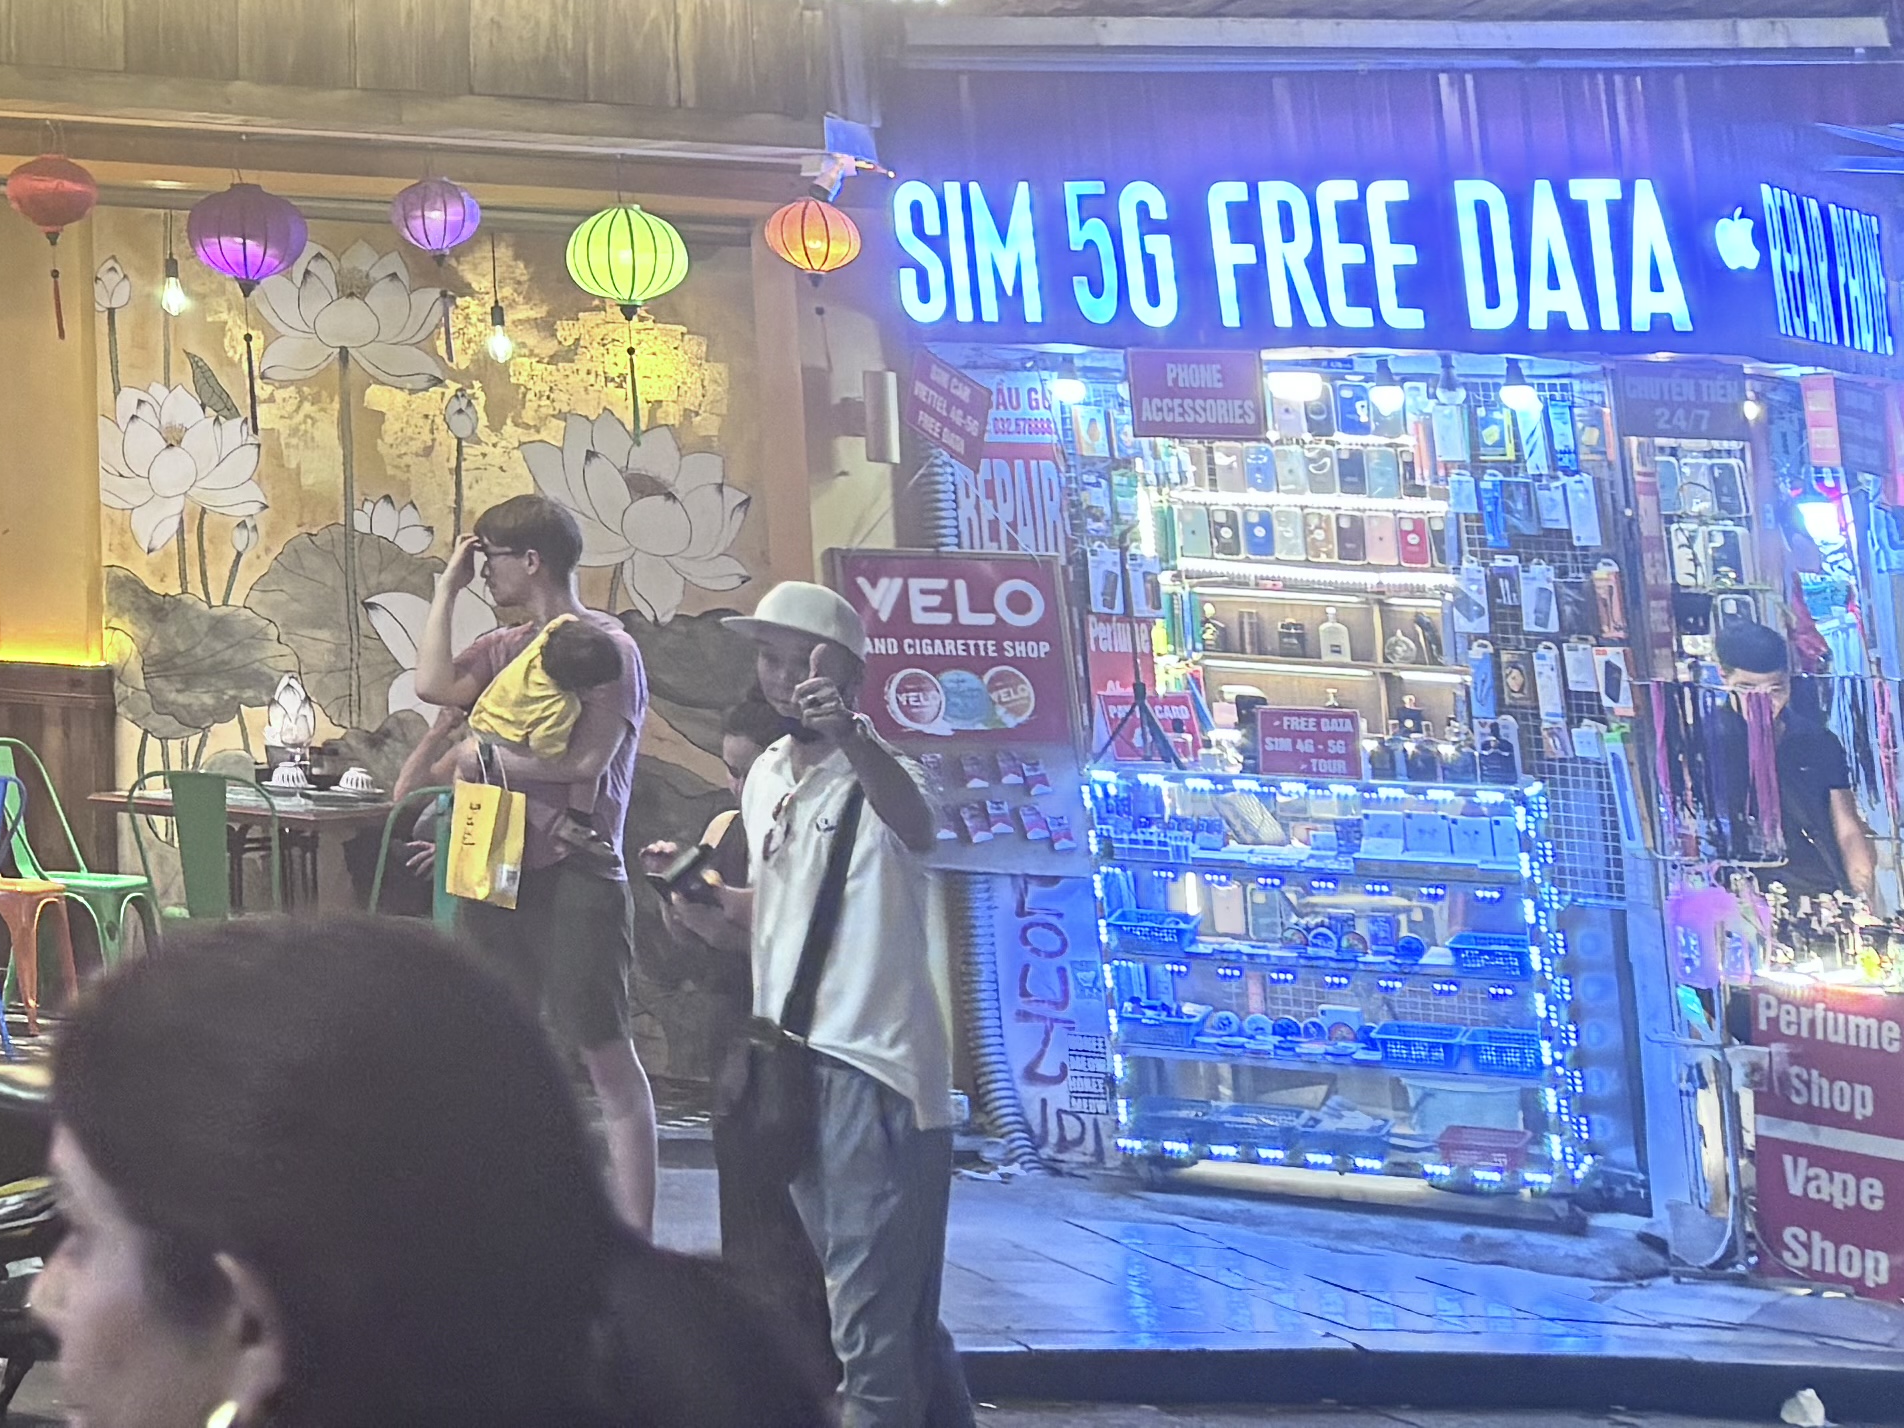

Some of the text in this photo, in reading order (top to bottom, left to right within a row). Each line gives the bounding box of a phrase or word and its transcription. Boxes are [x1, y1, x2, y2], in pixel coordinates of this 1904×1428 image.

[894, 178, 1694, 332] SIM 5G FREE DATA
[1166, 362, 1224, 389] PHONE
[917, 410, 943, 440] FREE
[1141, 397, 1256, 425] ACCESSORIES
[1655, 408, 1711, 431] 24/7
[954, 457, 1066, 564] REPAIR
[855, 577, 1046, 627] VELO
[865, 637, 1050, 658] AND CIGARETTE SHOP
[1155, 704, 1190, 719] CARD
[1283, 717, 1317, 732] FREE
[1320, 718, 1354, 732] DATA
[1311, 759, 1347, 774] TOUR
[1758, 993, 1902, 1053] Perfume
[1789, 1064, 1874, 1120] Shop
[1782, 1154, 1885, 1211] Vape
[1782, 1226, 1890, 1288] Shop
